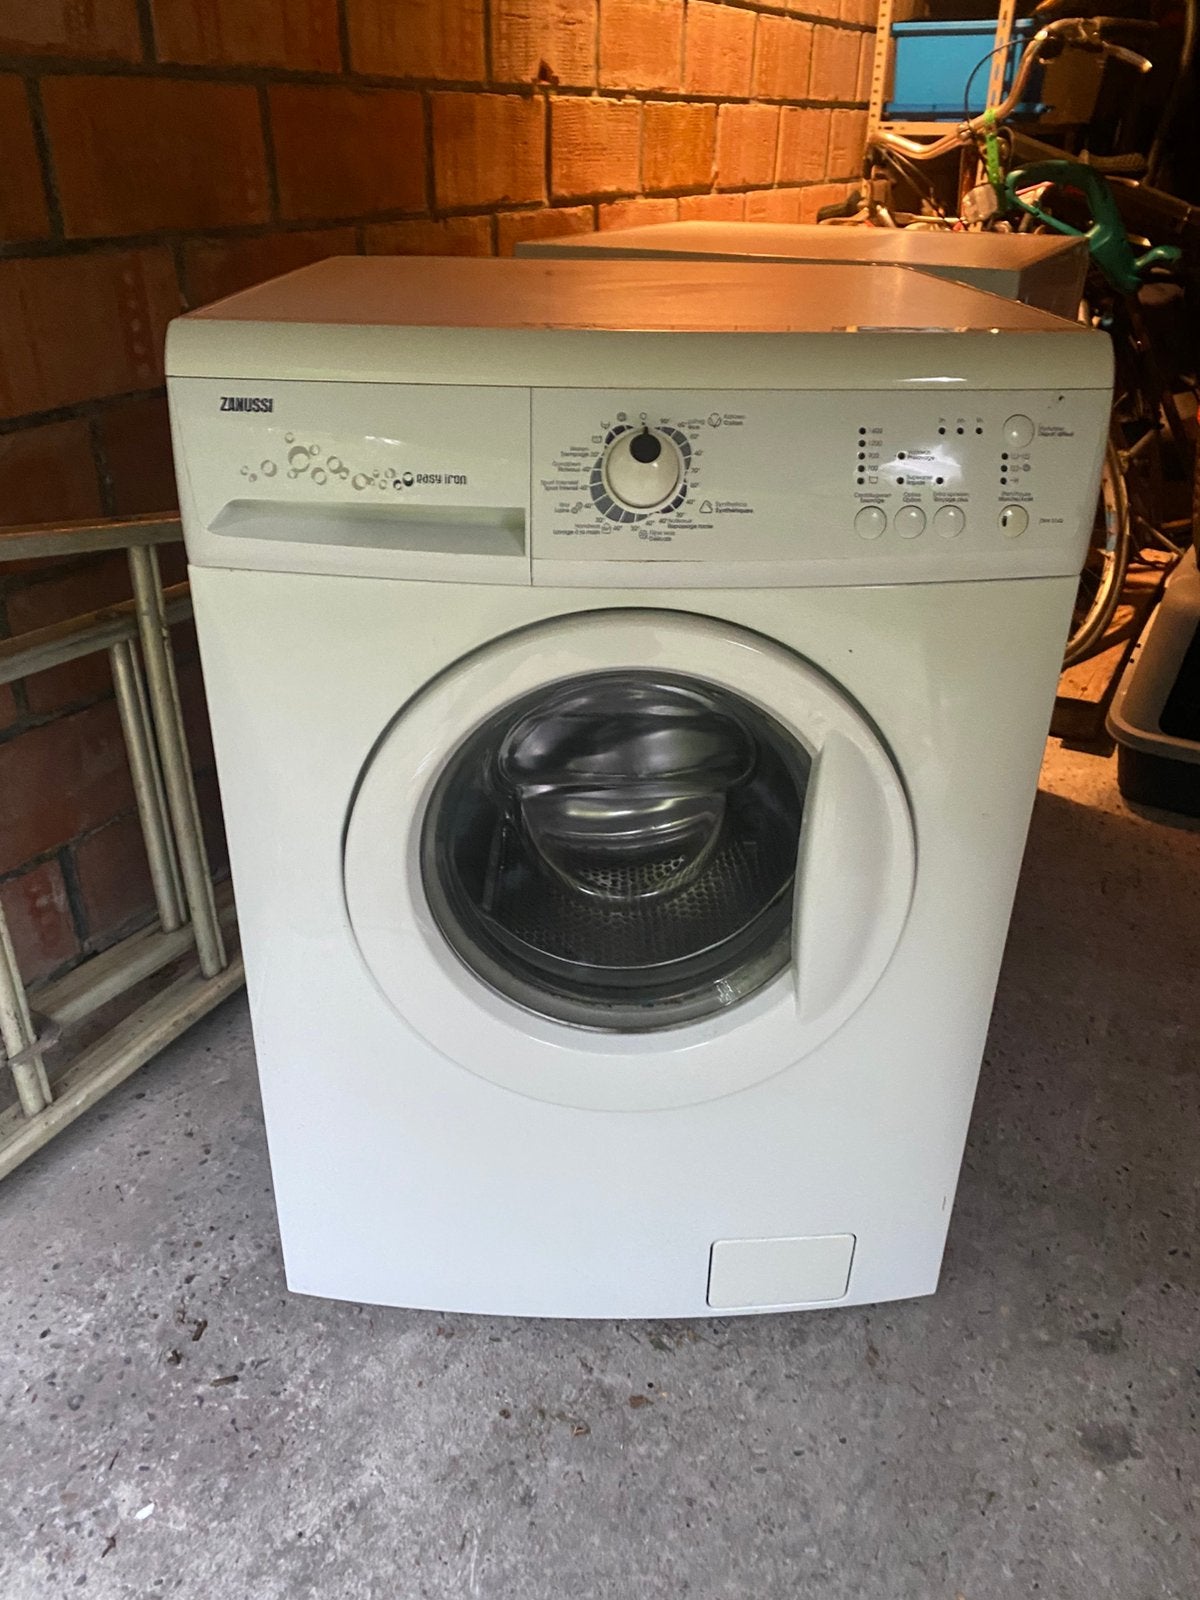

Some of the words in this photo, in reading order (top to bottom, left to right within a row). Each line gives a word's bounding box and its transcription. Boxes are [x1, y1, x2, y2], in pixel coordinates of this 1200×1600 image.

[220, 397, 274, 413] ZANUSSI
[416, 473, 442, 485] easy
[443, 473, 468, 485] iron
